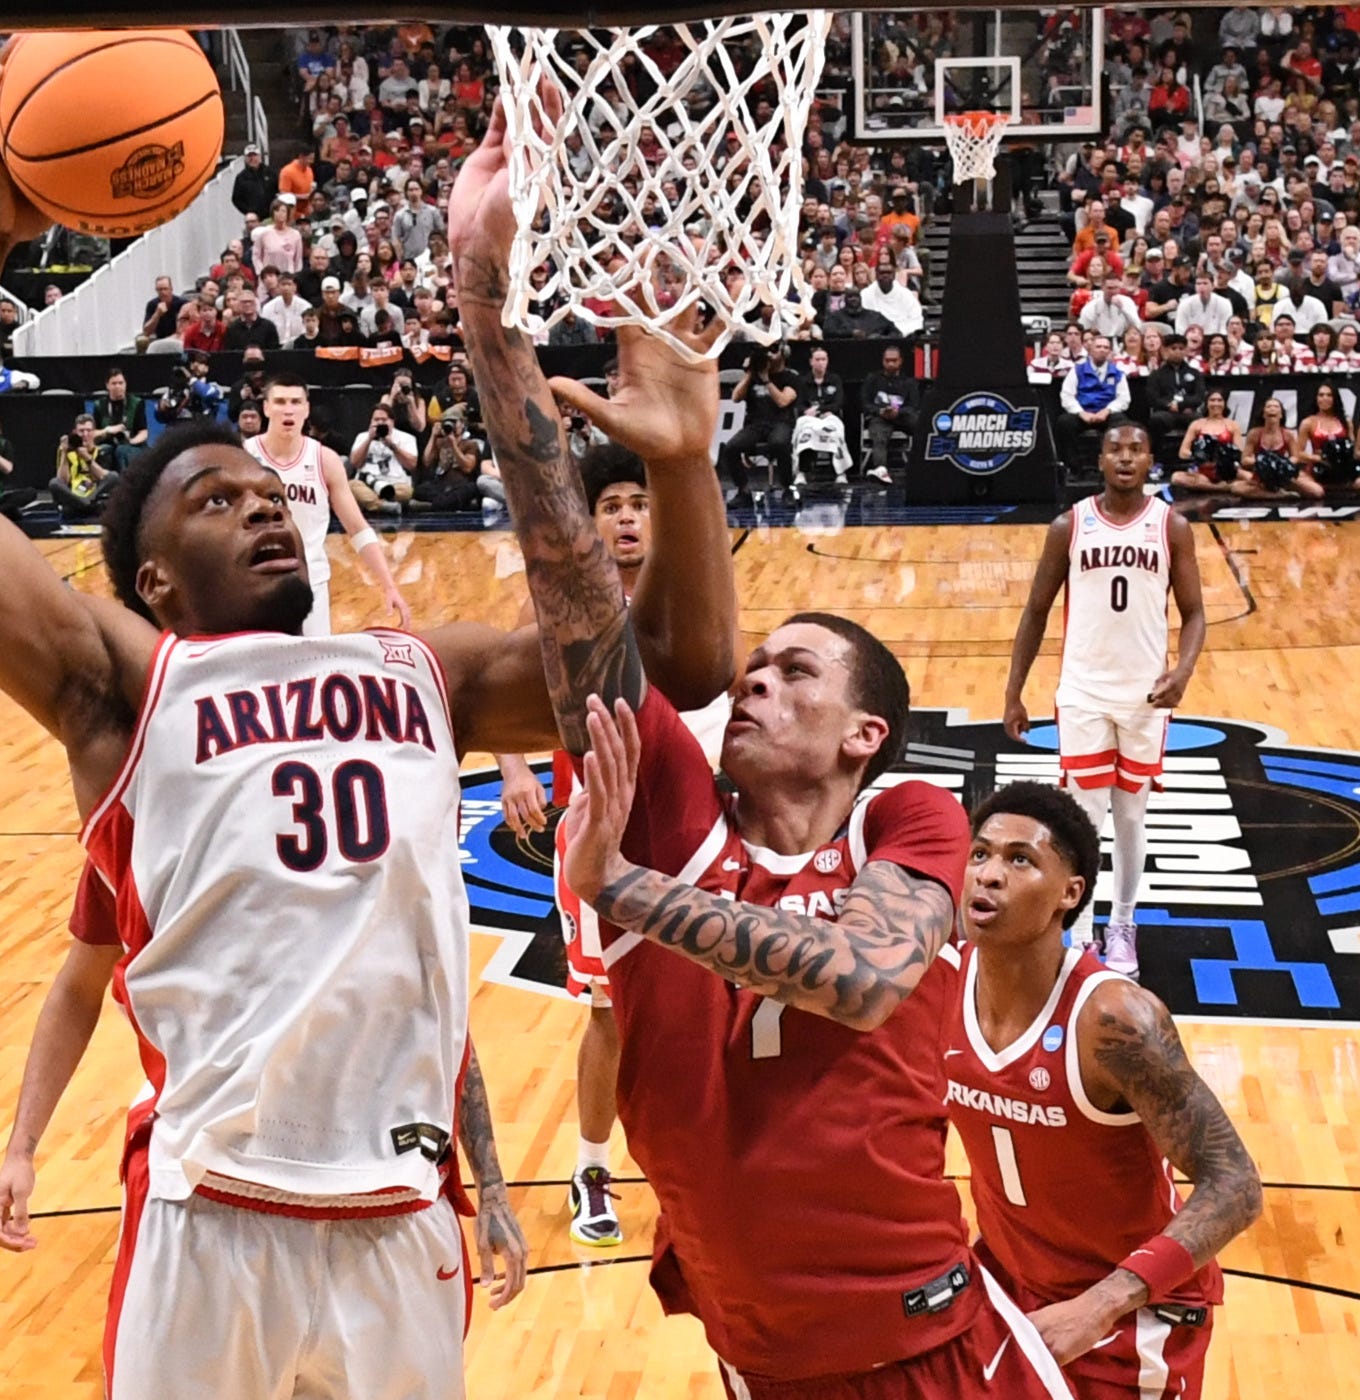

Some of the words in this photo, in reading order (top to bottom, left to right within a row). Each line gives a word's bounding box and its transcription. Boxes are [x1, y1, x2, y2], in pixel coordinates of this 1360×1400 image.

[951, 413, 1008, 431] MARCH
[958, 431, 1033, 448] MADNESS
[1080, 545, 1159, 573] ARIZONA
[1110, 575, 1128, 612] 0
[193, 673, 437, 764] ARIZONA
[271, 758, 391, 873] 30
[816, 851, 841, 870] SEC
[991, 1125, 1028, 1207] 1
